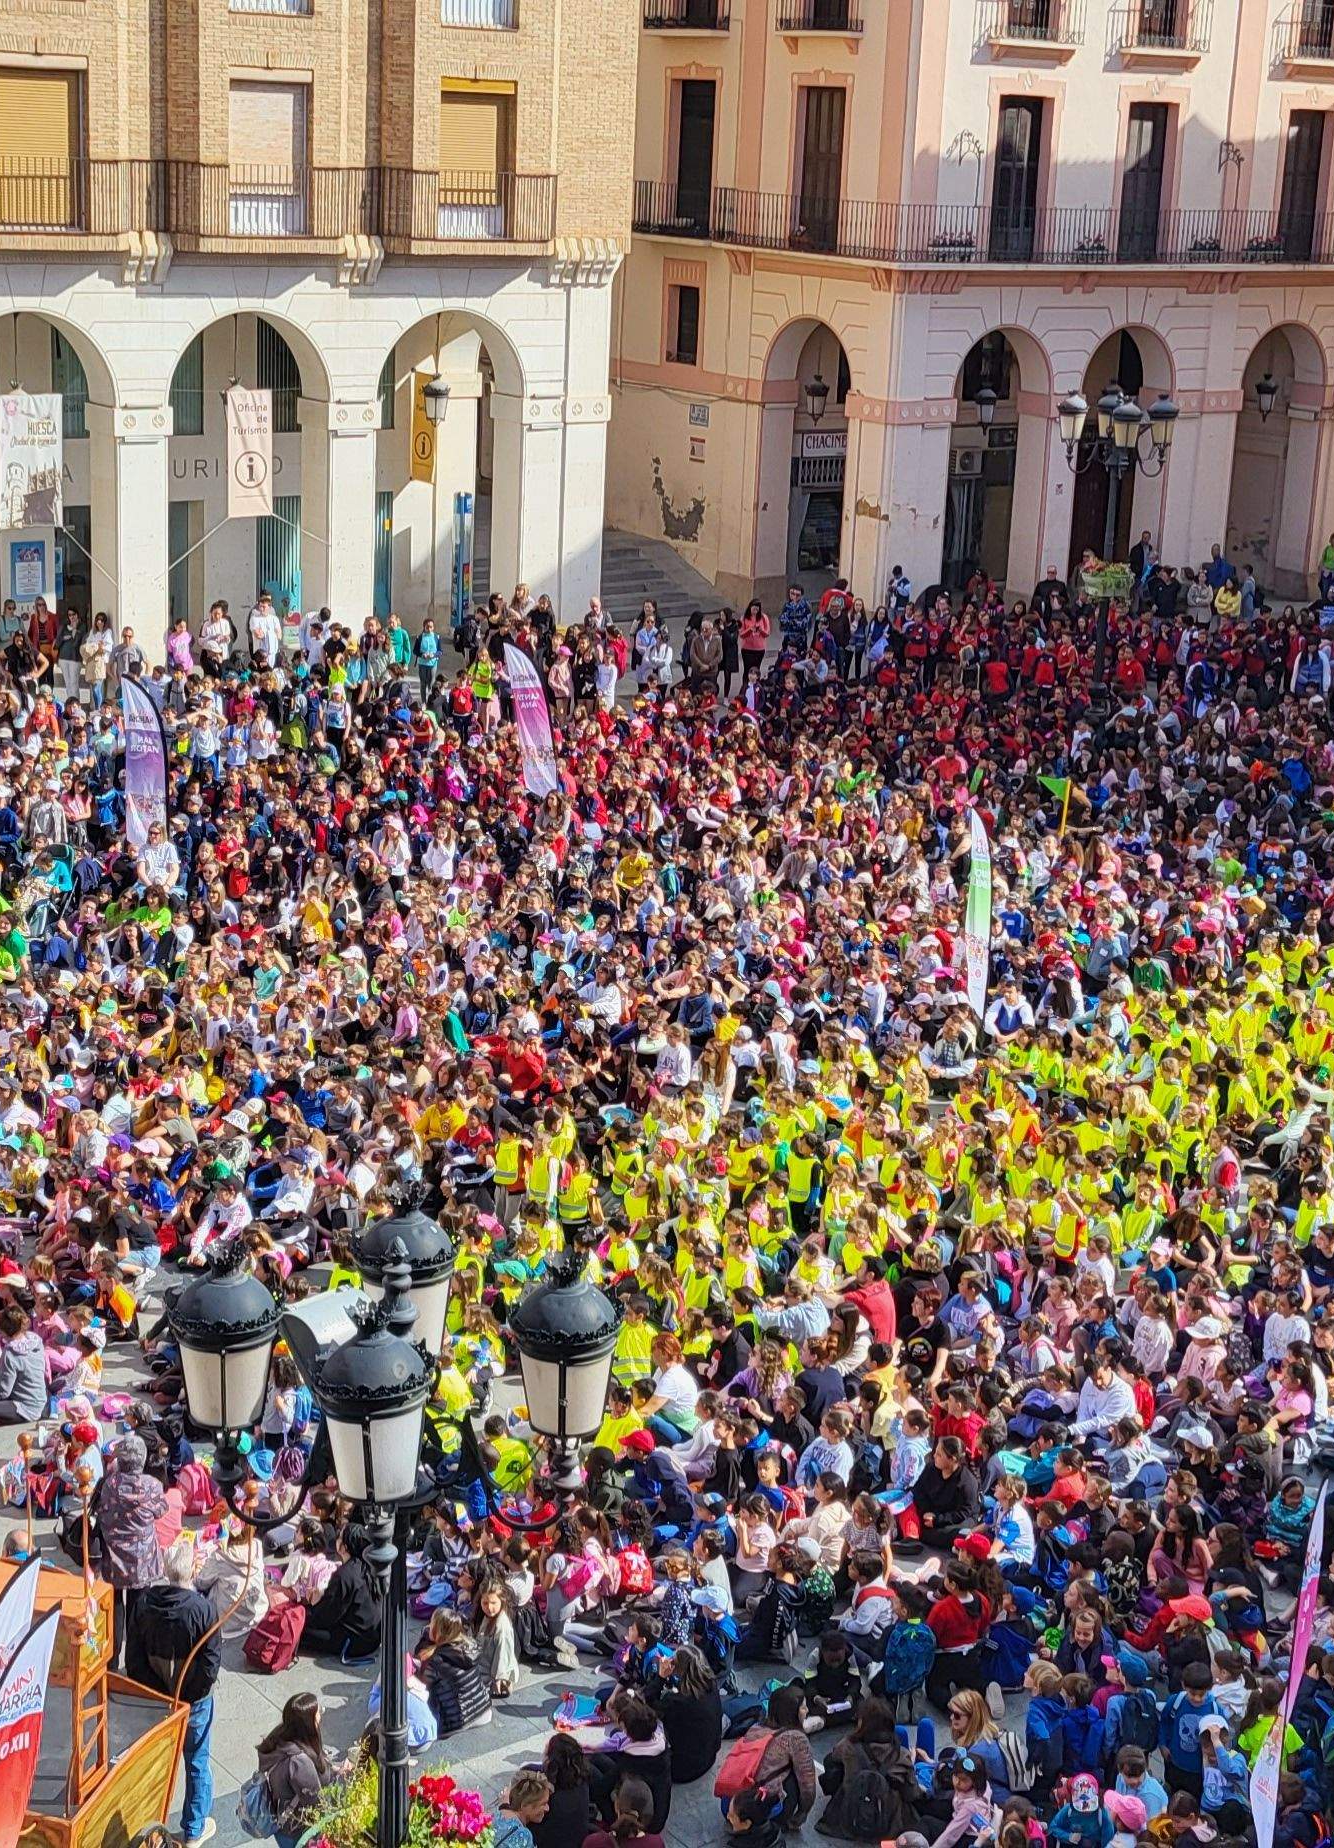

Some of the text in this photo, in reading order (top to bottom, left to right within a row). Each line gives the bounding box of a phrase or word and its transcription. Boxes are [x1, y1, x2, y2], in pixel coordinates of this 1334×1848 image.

[238, 403, 268, 413] Oficina
[256, 414, 268, 424] de
[27, 420, 57, 436] HUESCA
[232, 426, 268, 436] Turismo
[9, 1731, 31, 1753] XII
